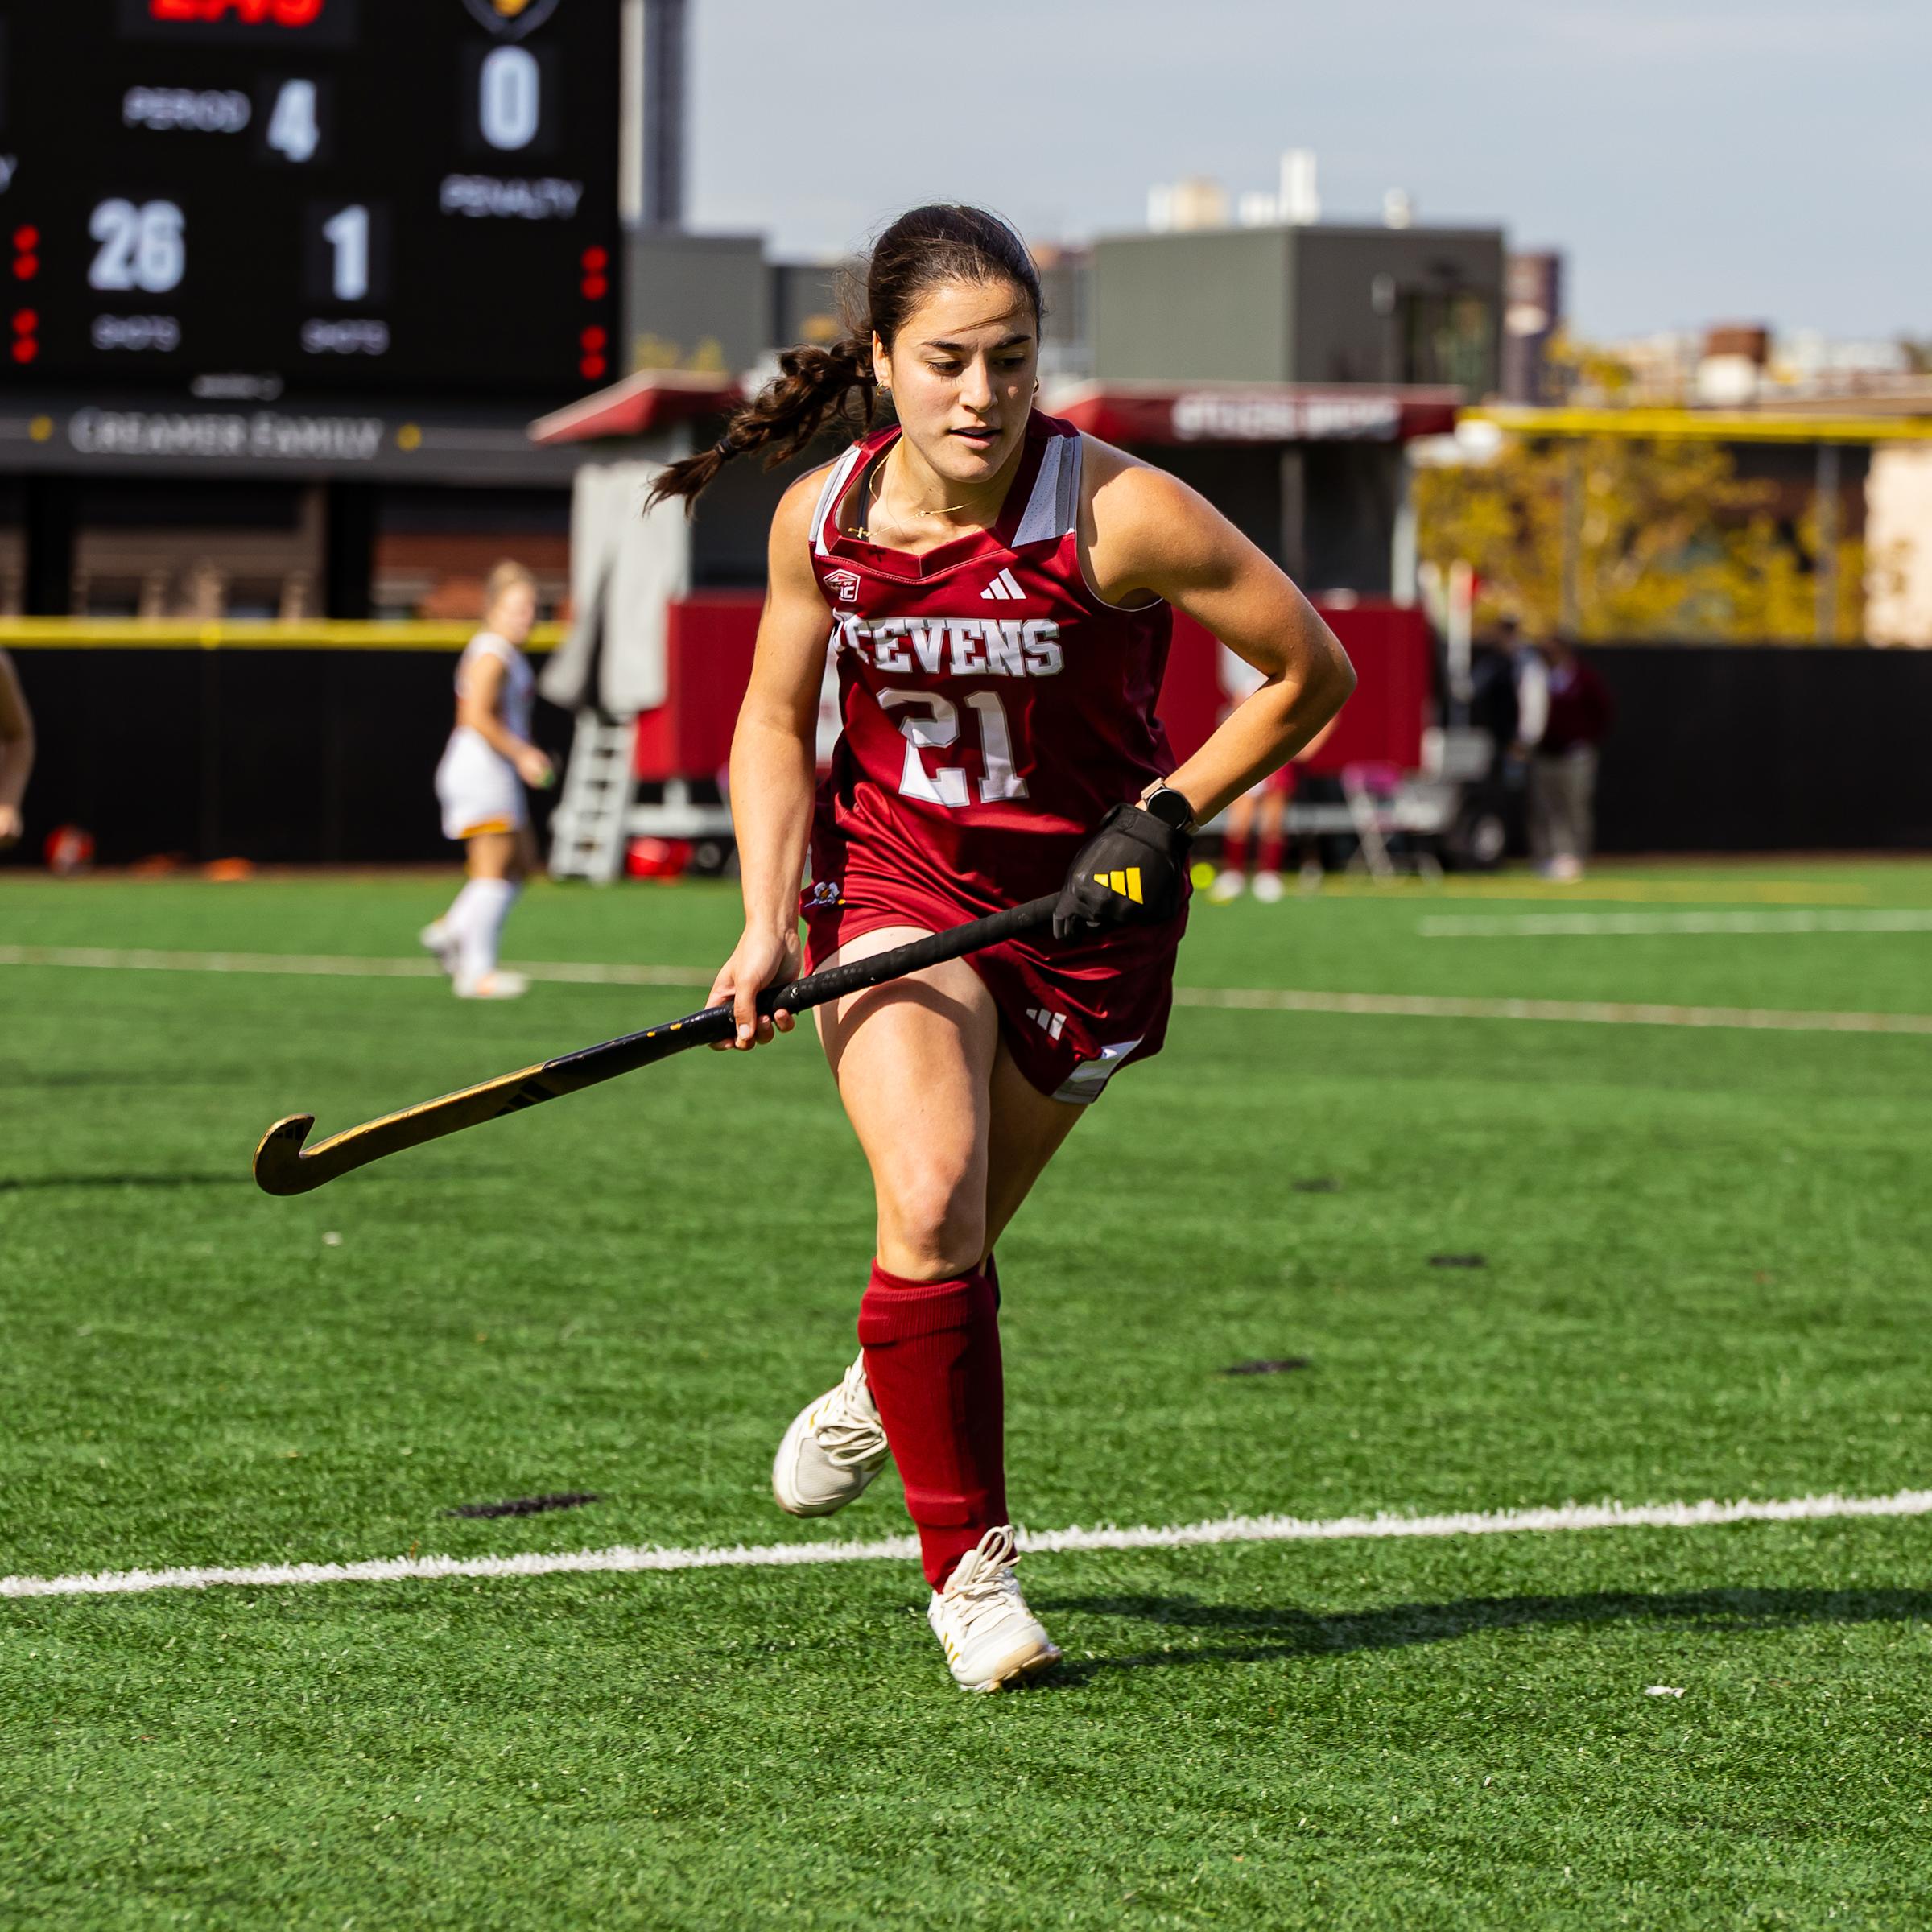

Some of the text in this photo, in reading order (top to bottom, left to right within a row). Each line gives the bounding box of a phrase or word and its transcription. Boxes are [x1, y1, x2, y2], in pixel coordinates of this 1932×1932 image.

[123, 80, 320, 161] PERIOD 4
[479, 45, 540, 151] 0
[440, 175, 581, 218] PENALTY
[89, 199, 185, 292] 26
[324, 205, 369, 300] 1
[92, 315, 180, 350] SHOTS
[301, 320, 390, 354] SHOTS
[876, 687, 1030, 807] 21
